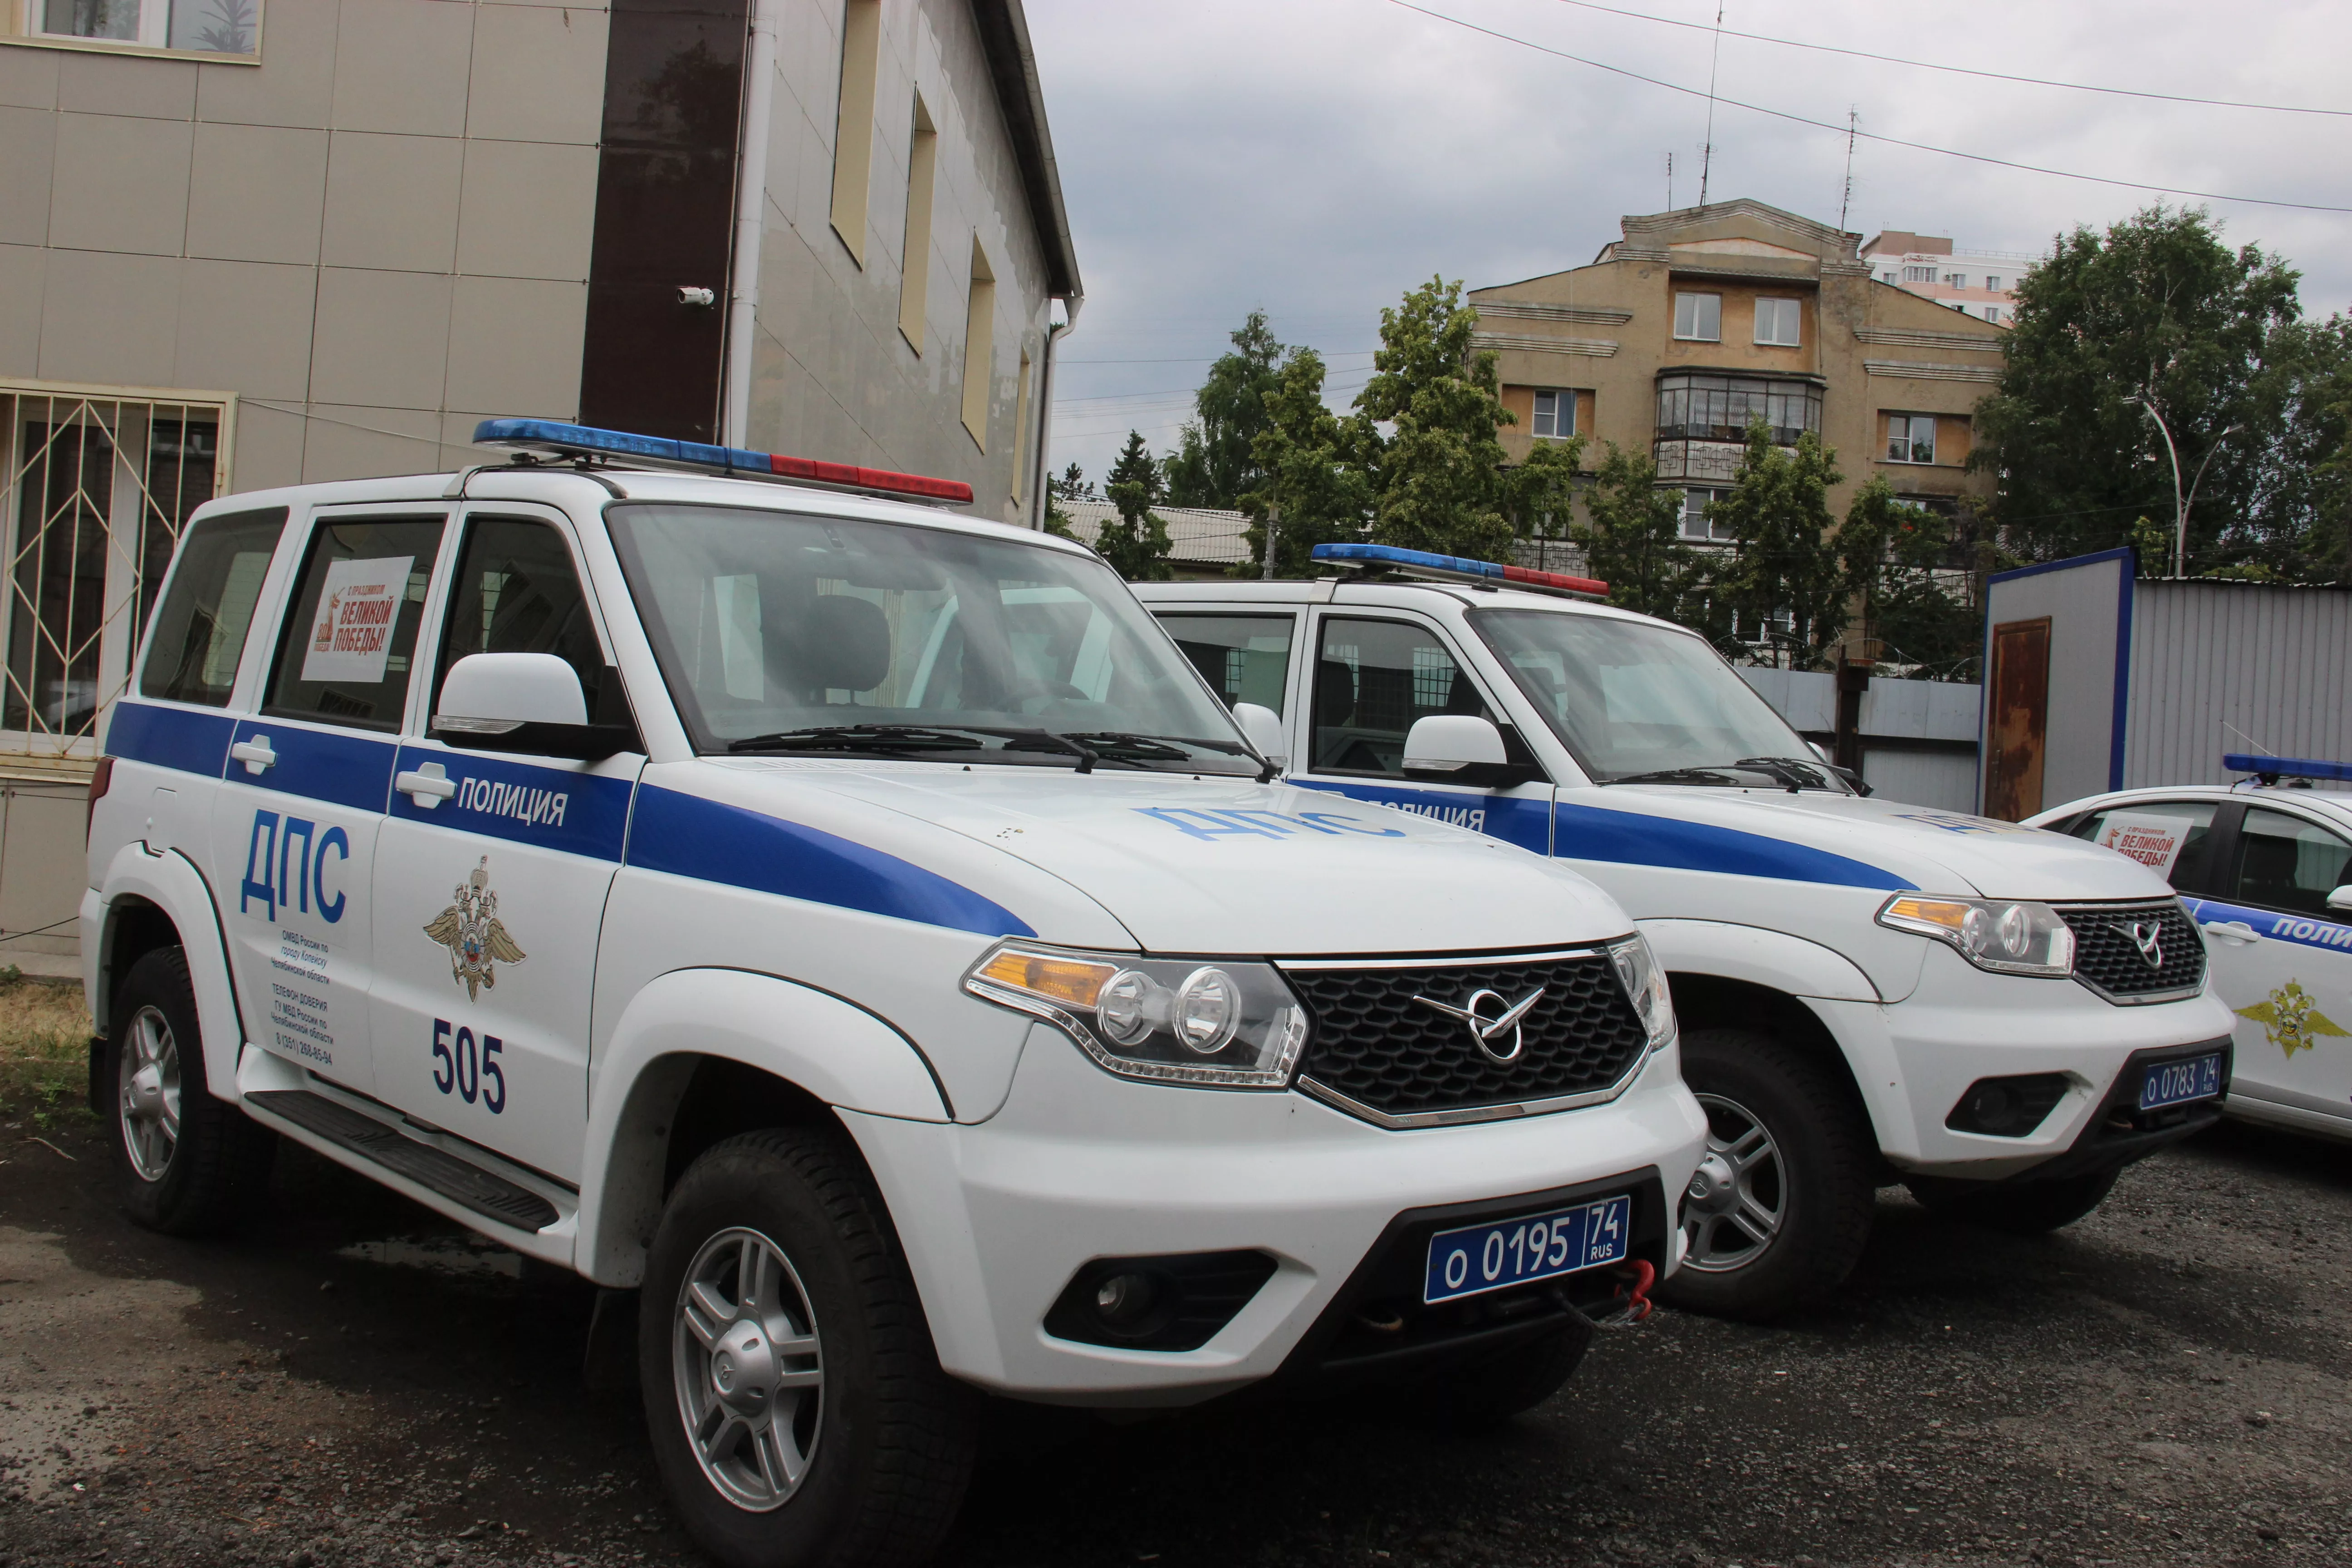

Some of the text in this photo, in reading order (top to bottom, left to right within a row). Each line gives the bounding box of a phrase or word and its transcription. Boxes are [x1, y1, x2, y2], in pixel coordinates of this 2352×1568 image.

[339, 595, 395, 625] ВЕЛИКОЙ
[333, 627, 387, 656] ПОБЕДЫ!
[458, 777, 569, 826] ПОЛИЦИЯ
[1127, 807, 1406, 841] ДПС
[2121, 834, 2175, 852] ВЕЛИКОЙ
[240, 808, 349, 924] ДПС
[282, 930, 328, 953] ОМВД России по
[2271, 918, 2352, 948] ПОЛИ
[271, 956, 330, 985] Челябинской области
[281, 946, 328, 969] городу Копейску
[272, 983, 328, 1012] ТЕЛЕФОН ДОВЕРИЯ
[271, 1012, 334, 1044] Челябинской области
[275, 1000, 327, 1030] ГУ МВД России по
[276, 1032, 333, 1065] 8 (351) 268-85-94
[432, 1018, 506, 1115] 505
[2161, 1063, 2195, 1099] 0783
[2204, 1058, 2215, 1082] 74
[2203, 1083, 2213, 1092] RUS
[1482, 1217, 1570, 1281] 0195
[1591, 1203, 1618, 1245] 74
[1591, 1243, 1613, 1260] RUS
